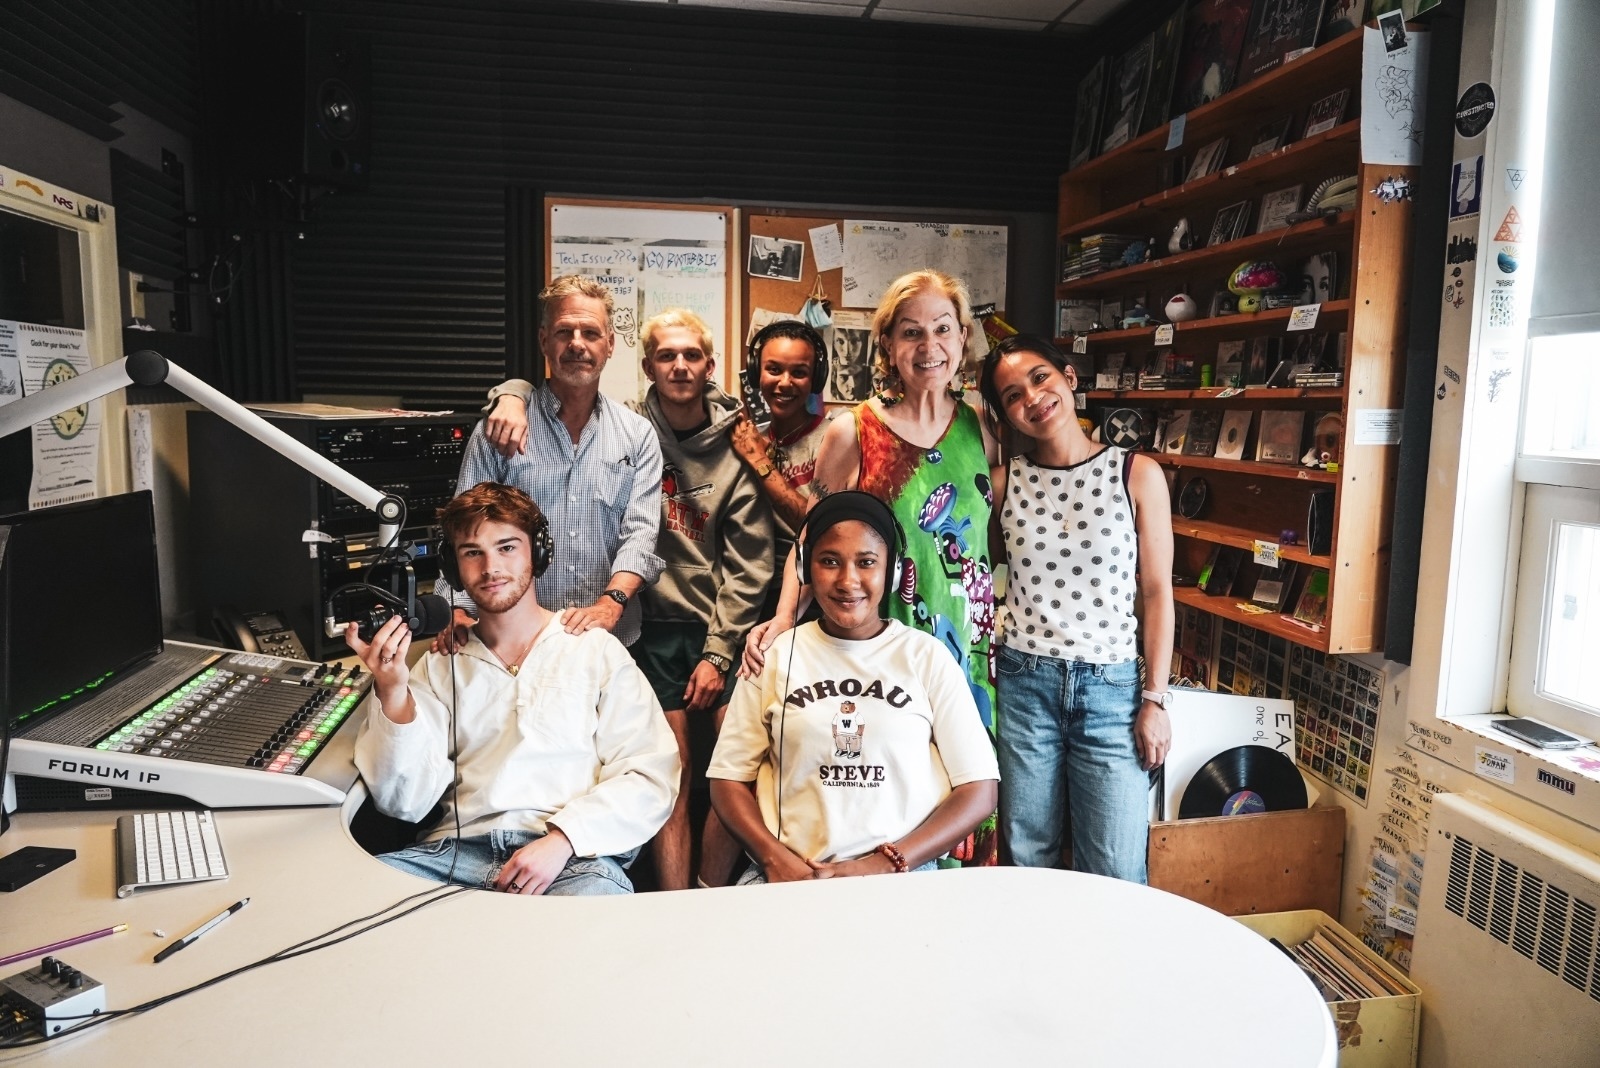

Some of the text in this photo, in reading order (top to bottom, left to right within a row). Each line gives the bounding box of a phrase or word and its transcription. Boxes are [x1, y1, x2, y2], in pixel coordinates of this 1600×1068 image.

[53, 194, 73, 210] NRS
[555, 252, 580, 265] Tech
[785, 679, 913, 708] WHOAU
[842, 720, 851, 728] W
[48, 759, 160, 783] FORUM IP
[819, 765, 885, 781] STEVE
